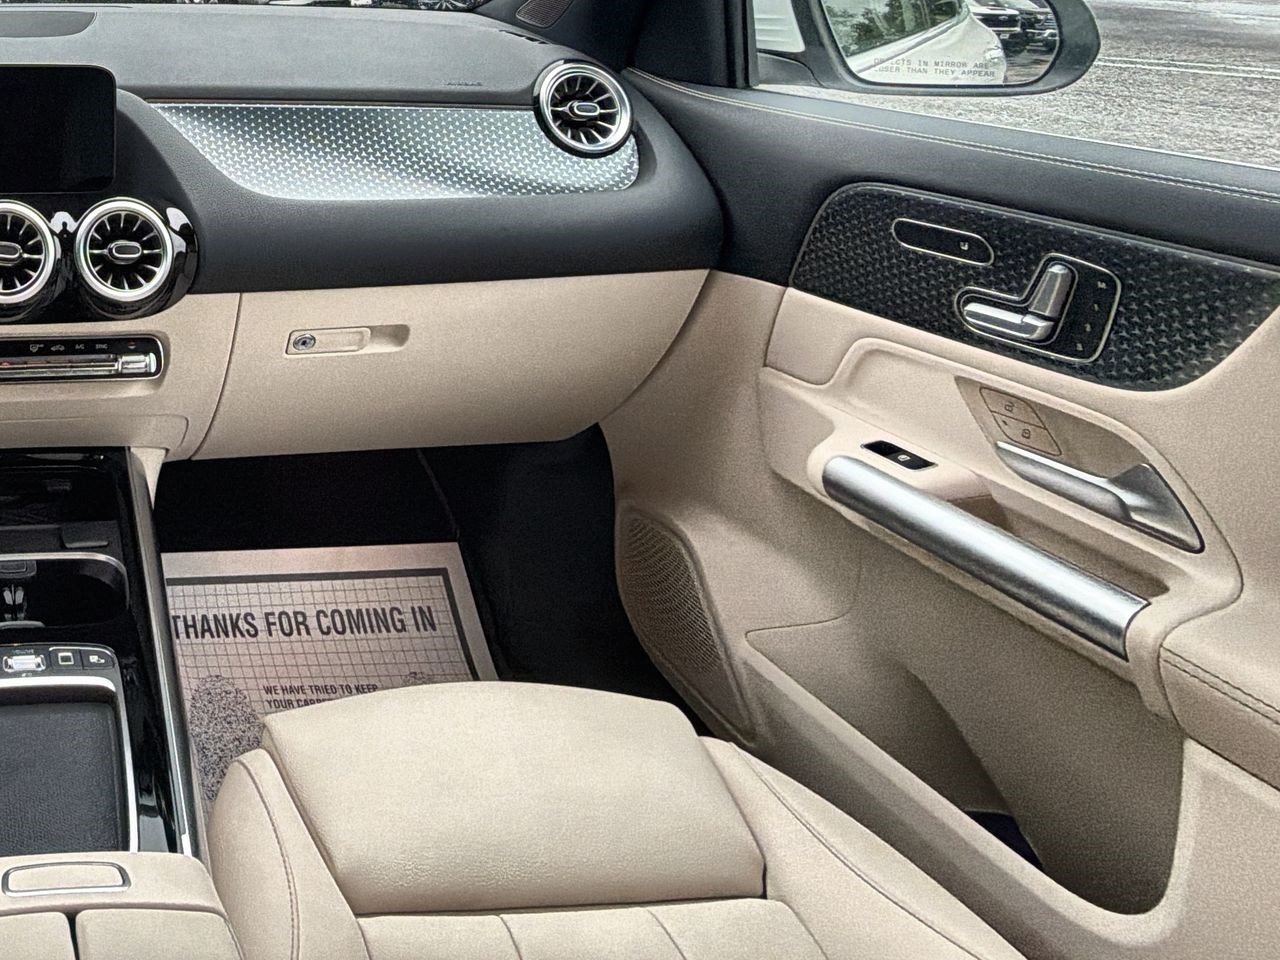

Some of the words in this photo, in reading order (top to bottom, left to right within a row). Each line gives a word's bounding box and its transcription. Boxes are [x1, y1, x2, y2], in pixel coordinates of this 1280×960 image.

[934, 61, 968, 69] MIRROR
[961, 69, 995, 77] APPEAR
[172, 612, 259, 639] THANKS
[264, 611, 311, 637] FOR
[316, 607, 407, 635] COMING
[411, 605, 437, 632] IN
[263, 685, 280, 695] WE
[281, 684, 308, 695] HAVE
[308, 684, 337, 695] TRIED
[339, 683, 353, 694] TO
[354, 683, 378, 693] KEEP
[266, 699, 295, 709] YOUR
